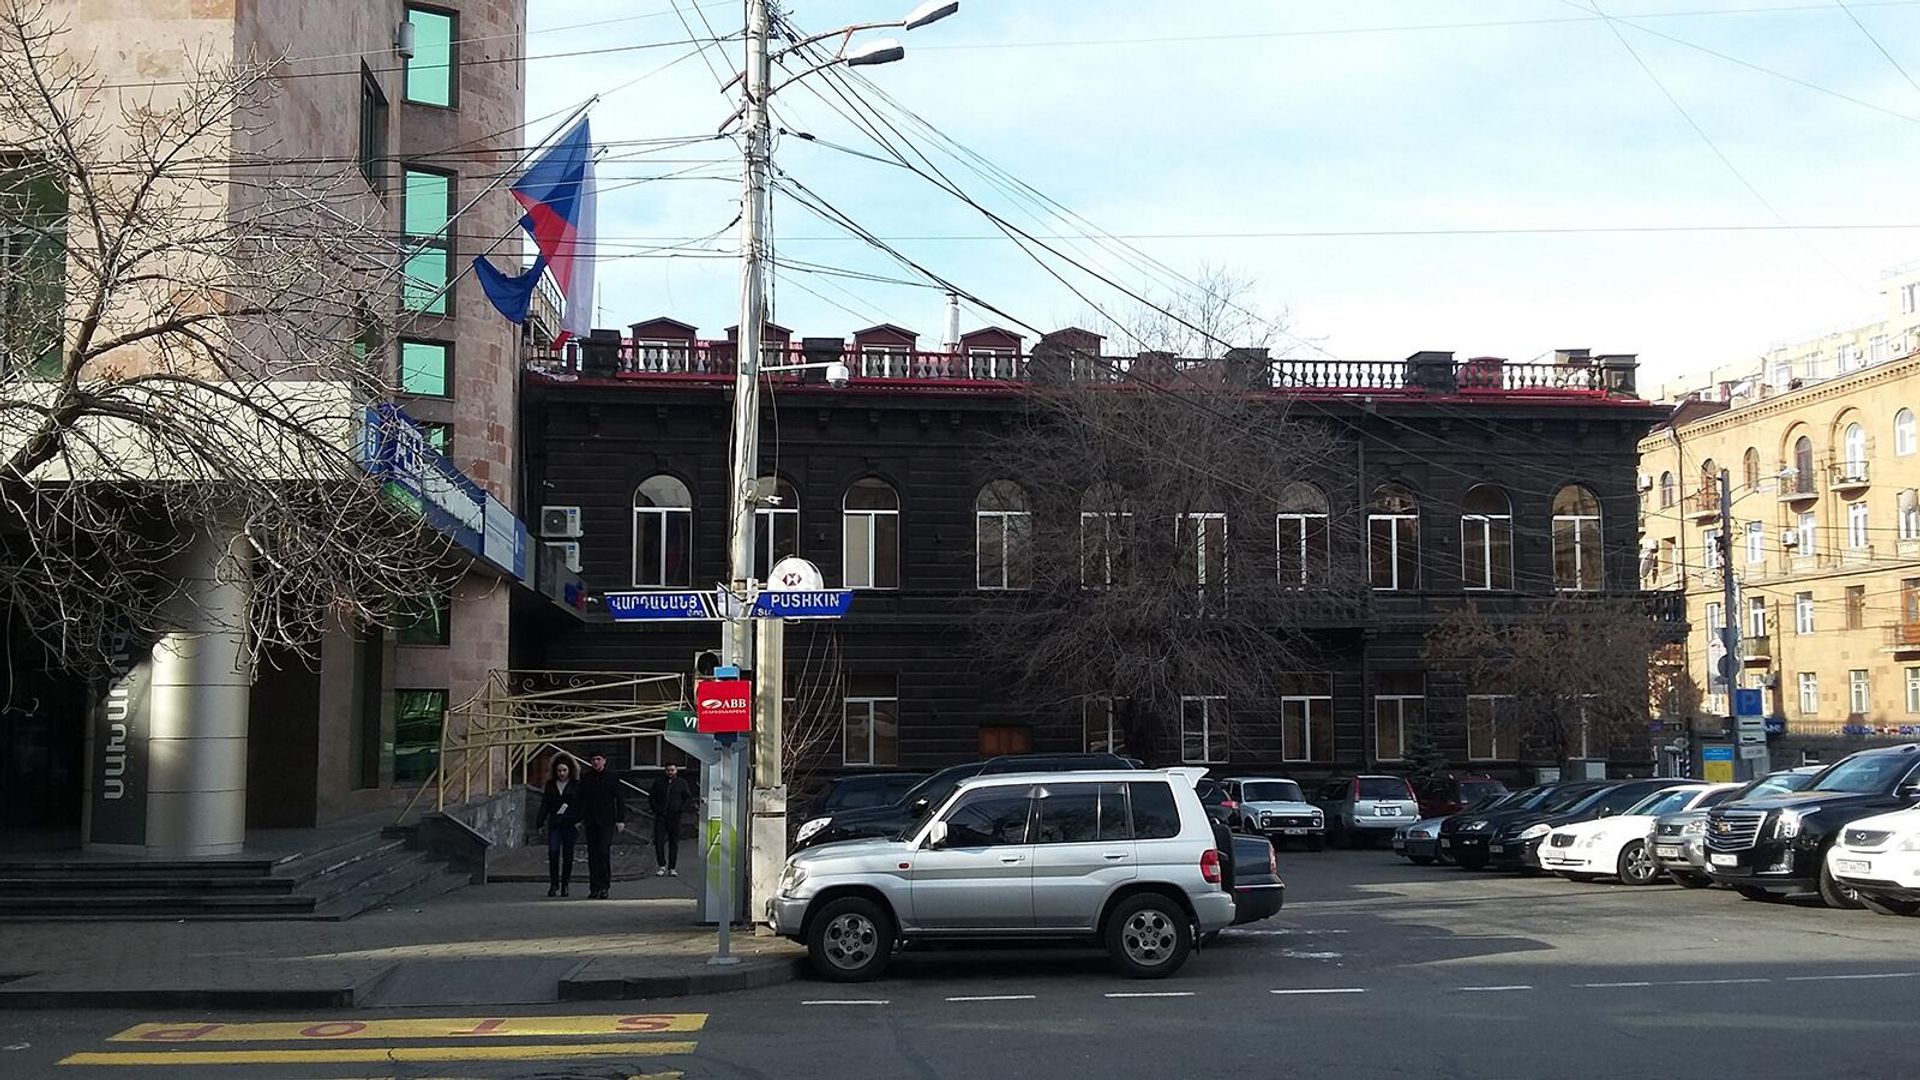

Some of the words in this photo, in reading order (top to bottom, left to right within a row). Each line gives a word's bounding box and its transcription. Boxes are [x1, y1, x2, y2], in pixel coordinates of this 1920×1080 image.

[612, 595, 698, 610] ՎԱՐԴԱՆԱՆՑ
[771, 594, 840, 608] PUSHKIN
[722, 698, 747, 709] ABB
[139, 1016, 677, 1039] STOP
